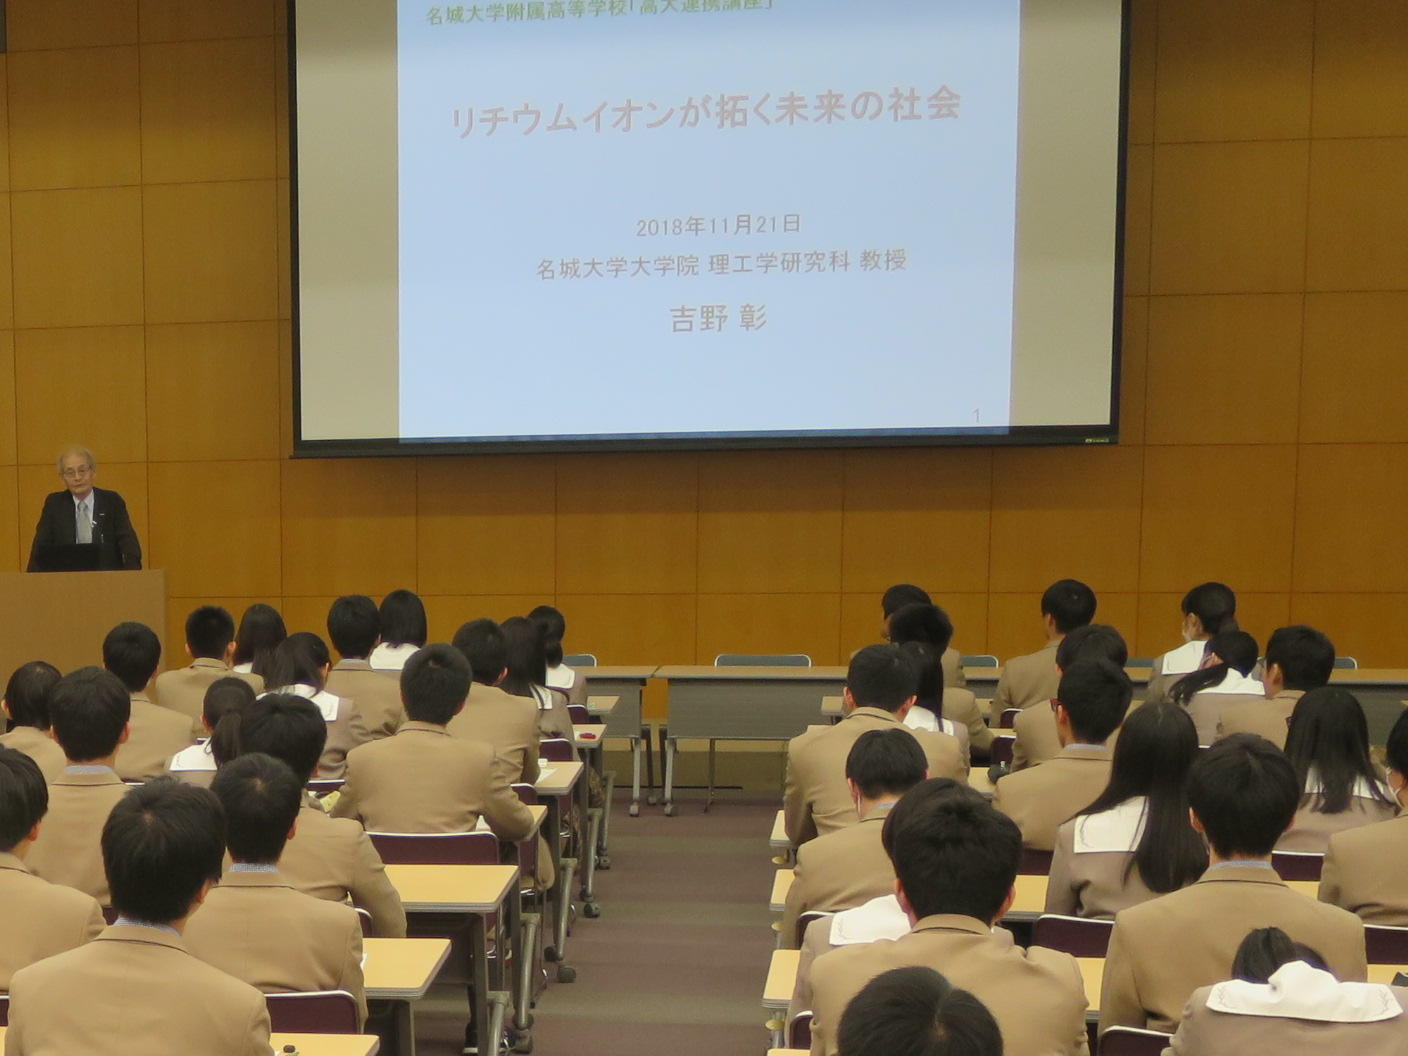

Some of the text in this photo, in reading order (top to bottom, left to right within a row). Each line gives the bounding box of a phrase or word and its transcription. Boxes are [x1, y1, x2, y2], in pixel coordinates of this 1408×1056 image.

[452, 84, 962, 139] リチウムイオンが拓く未来の社会
[636, 213, 802, 237] 2018年11月21日
[536, 247, 907, 281] 名城大学大学院 理工学研究科 教授
[670, 303, 768, 333] 吉野 彰
